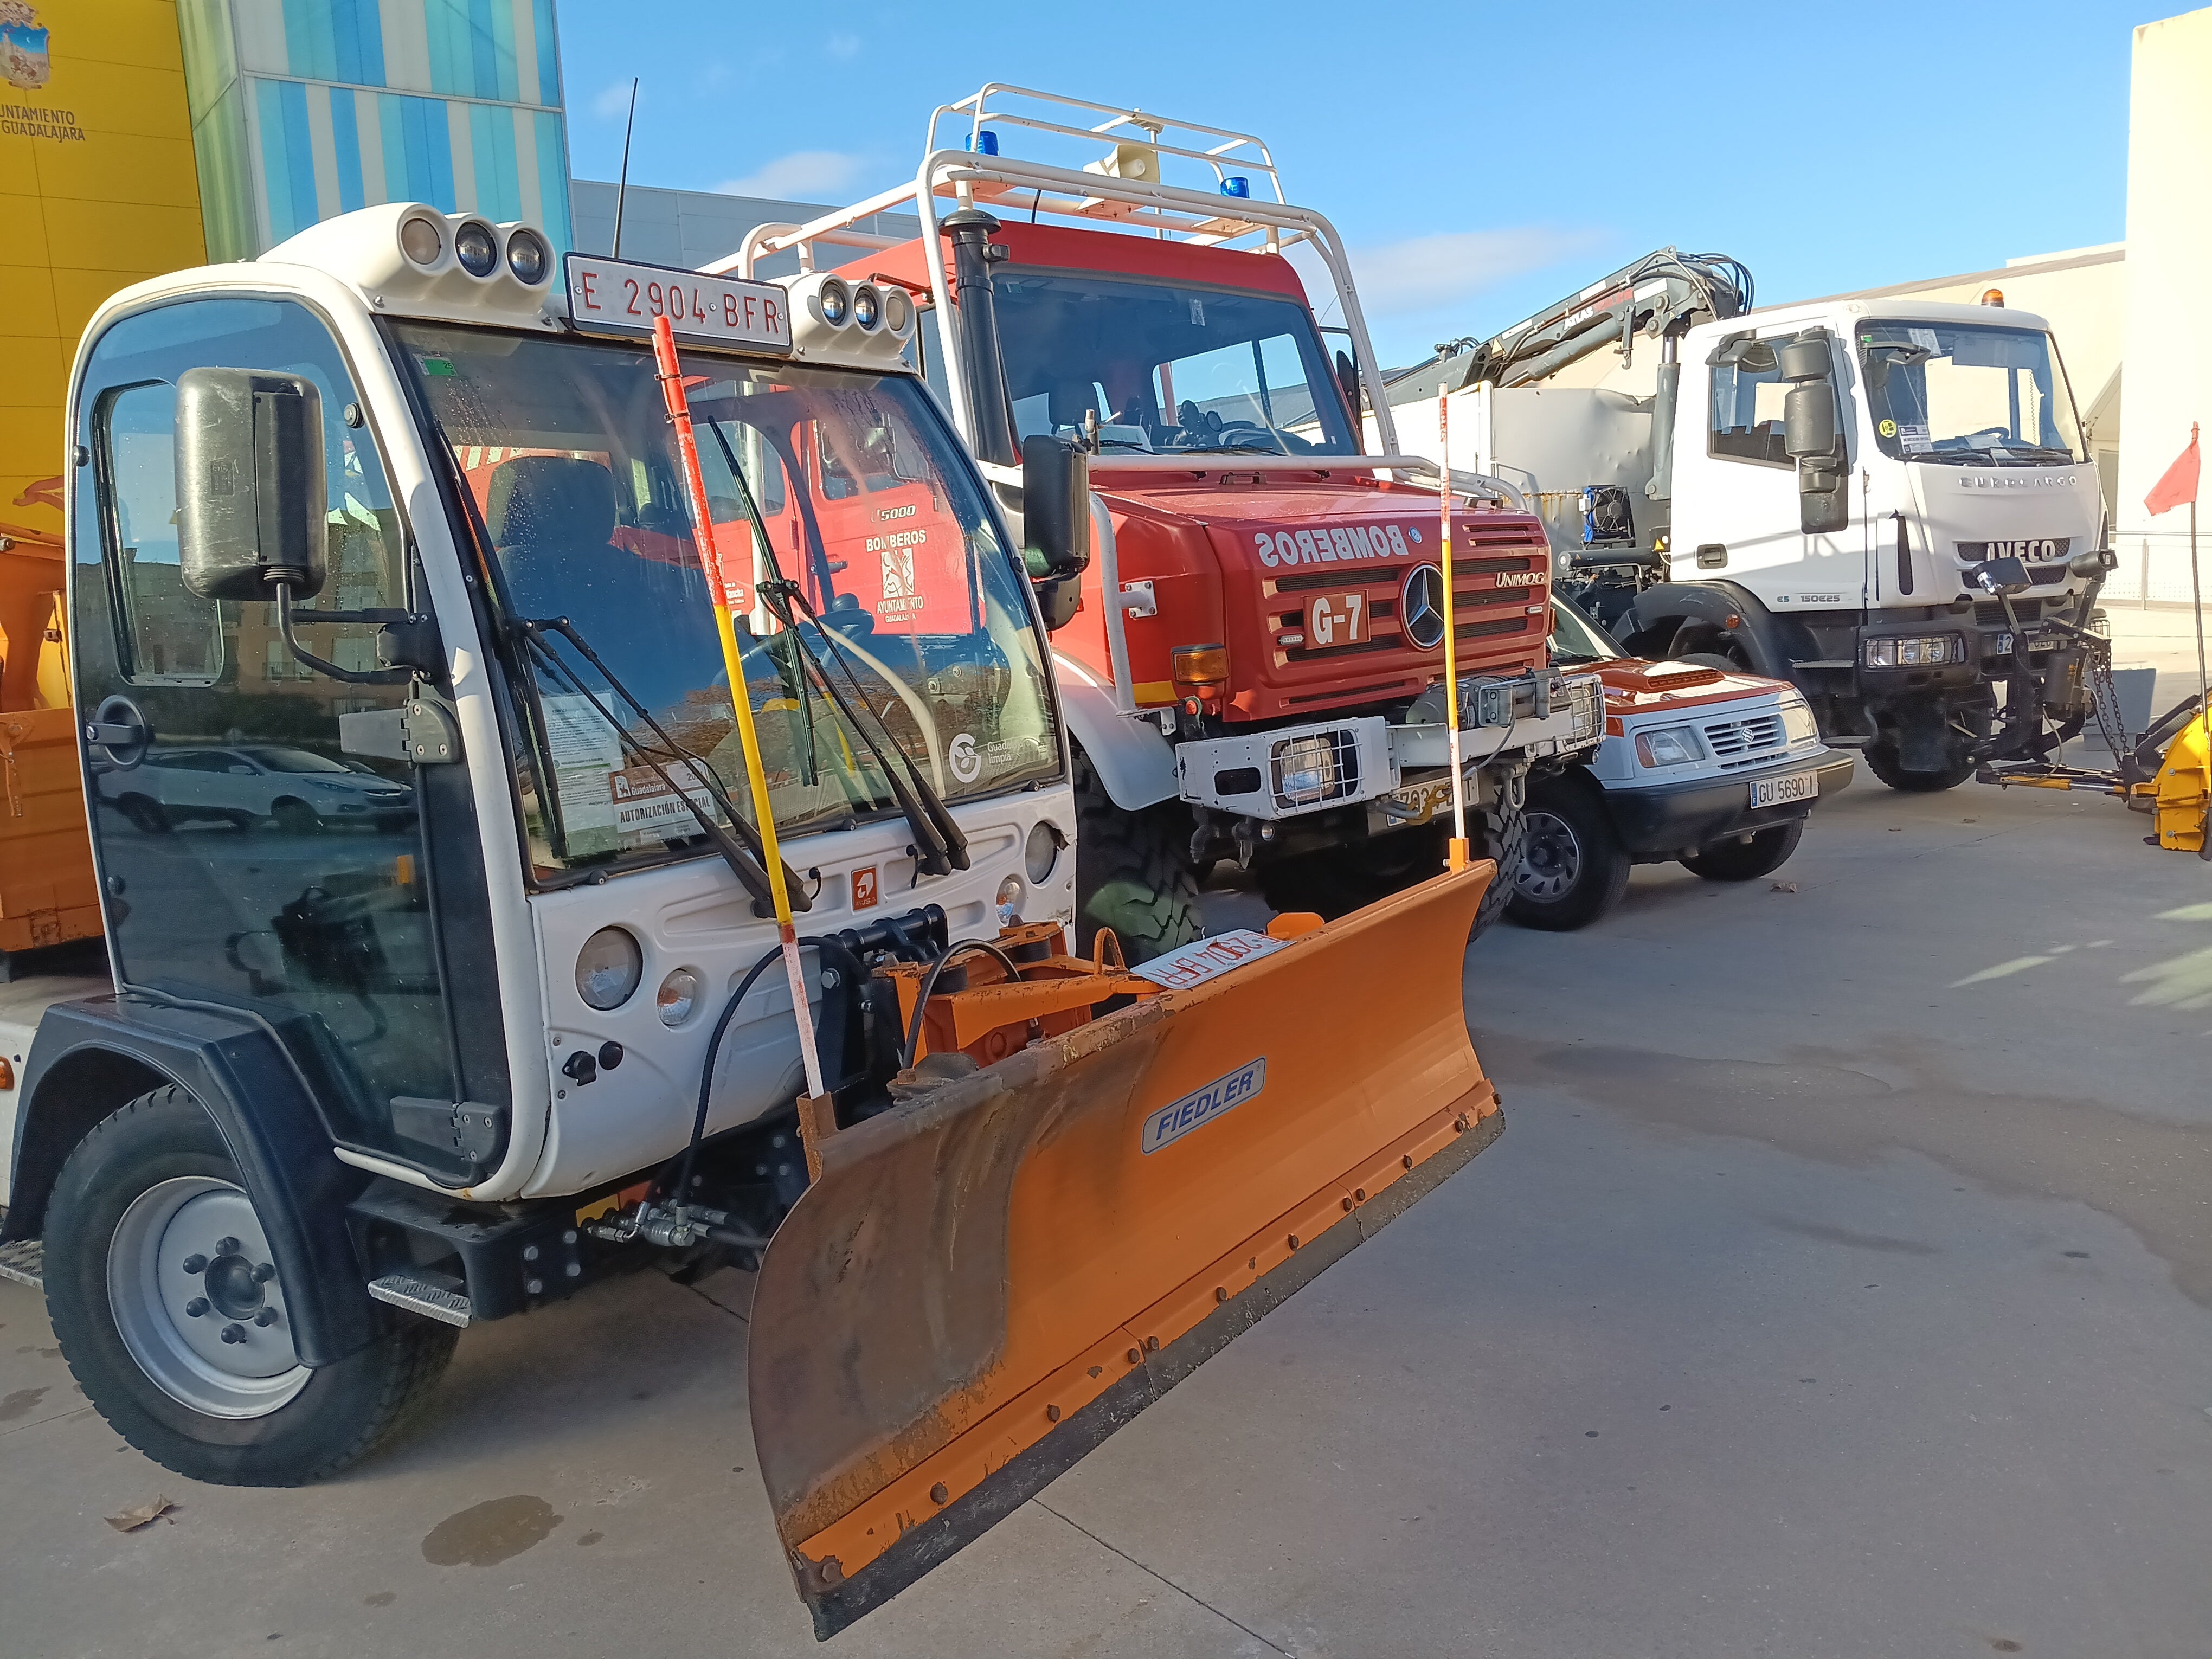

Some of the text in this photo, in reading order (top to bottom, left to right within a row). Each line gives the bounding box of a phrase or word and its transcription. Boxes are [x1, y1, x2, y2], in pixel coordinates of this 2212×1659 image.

[2, 120, 85, 142] GUADALAJARA
[582, 273, 778, 333] E 2904 BFR
[1564, 306, 1594, 330] ATLAS
[1959, 475, 2076, 487] EUROCARGO
[1986, 540, 2055, 562] IVECO
[1496, 572, 1545, 588] UNIMOG
[1312, 595, 1361, 645] G-7
[988, 751, 1011, 764] limpia
[631, 783, 666, 796] Guadalajara
[1759, 782, 1774, 802] GU
[1778, 777, 1805, 800] 5690
[620, 796, 711, 824] AUTORIZACIÓN ESCIAL
[1147, 957, 1213, 985] BFR
[1156, 1069, 1254, 1141] FIEDLER
